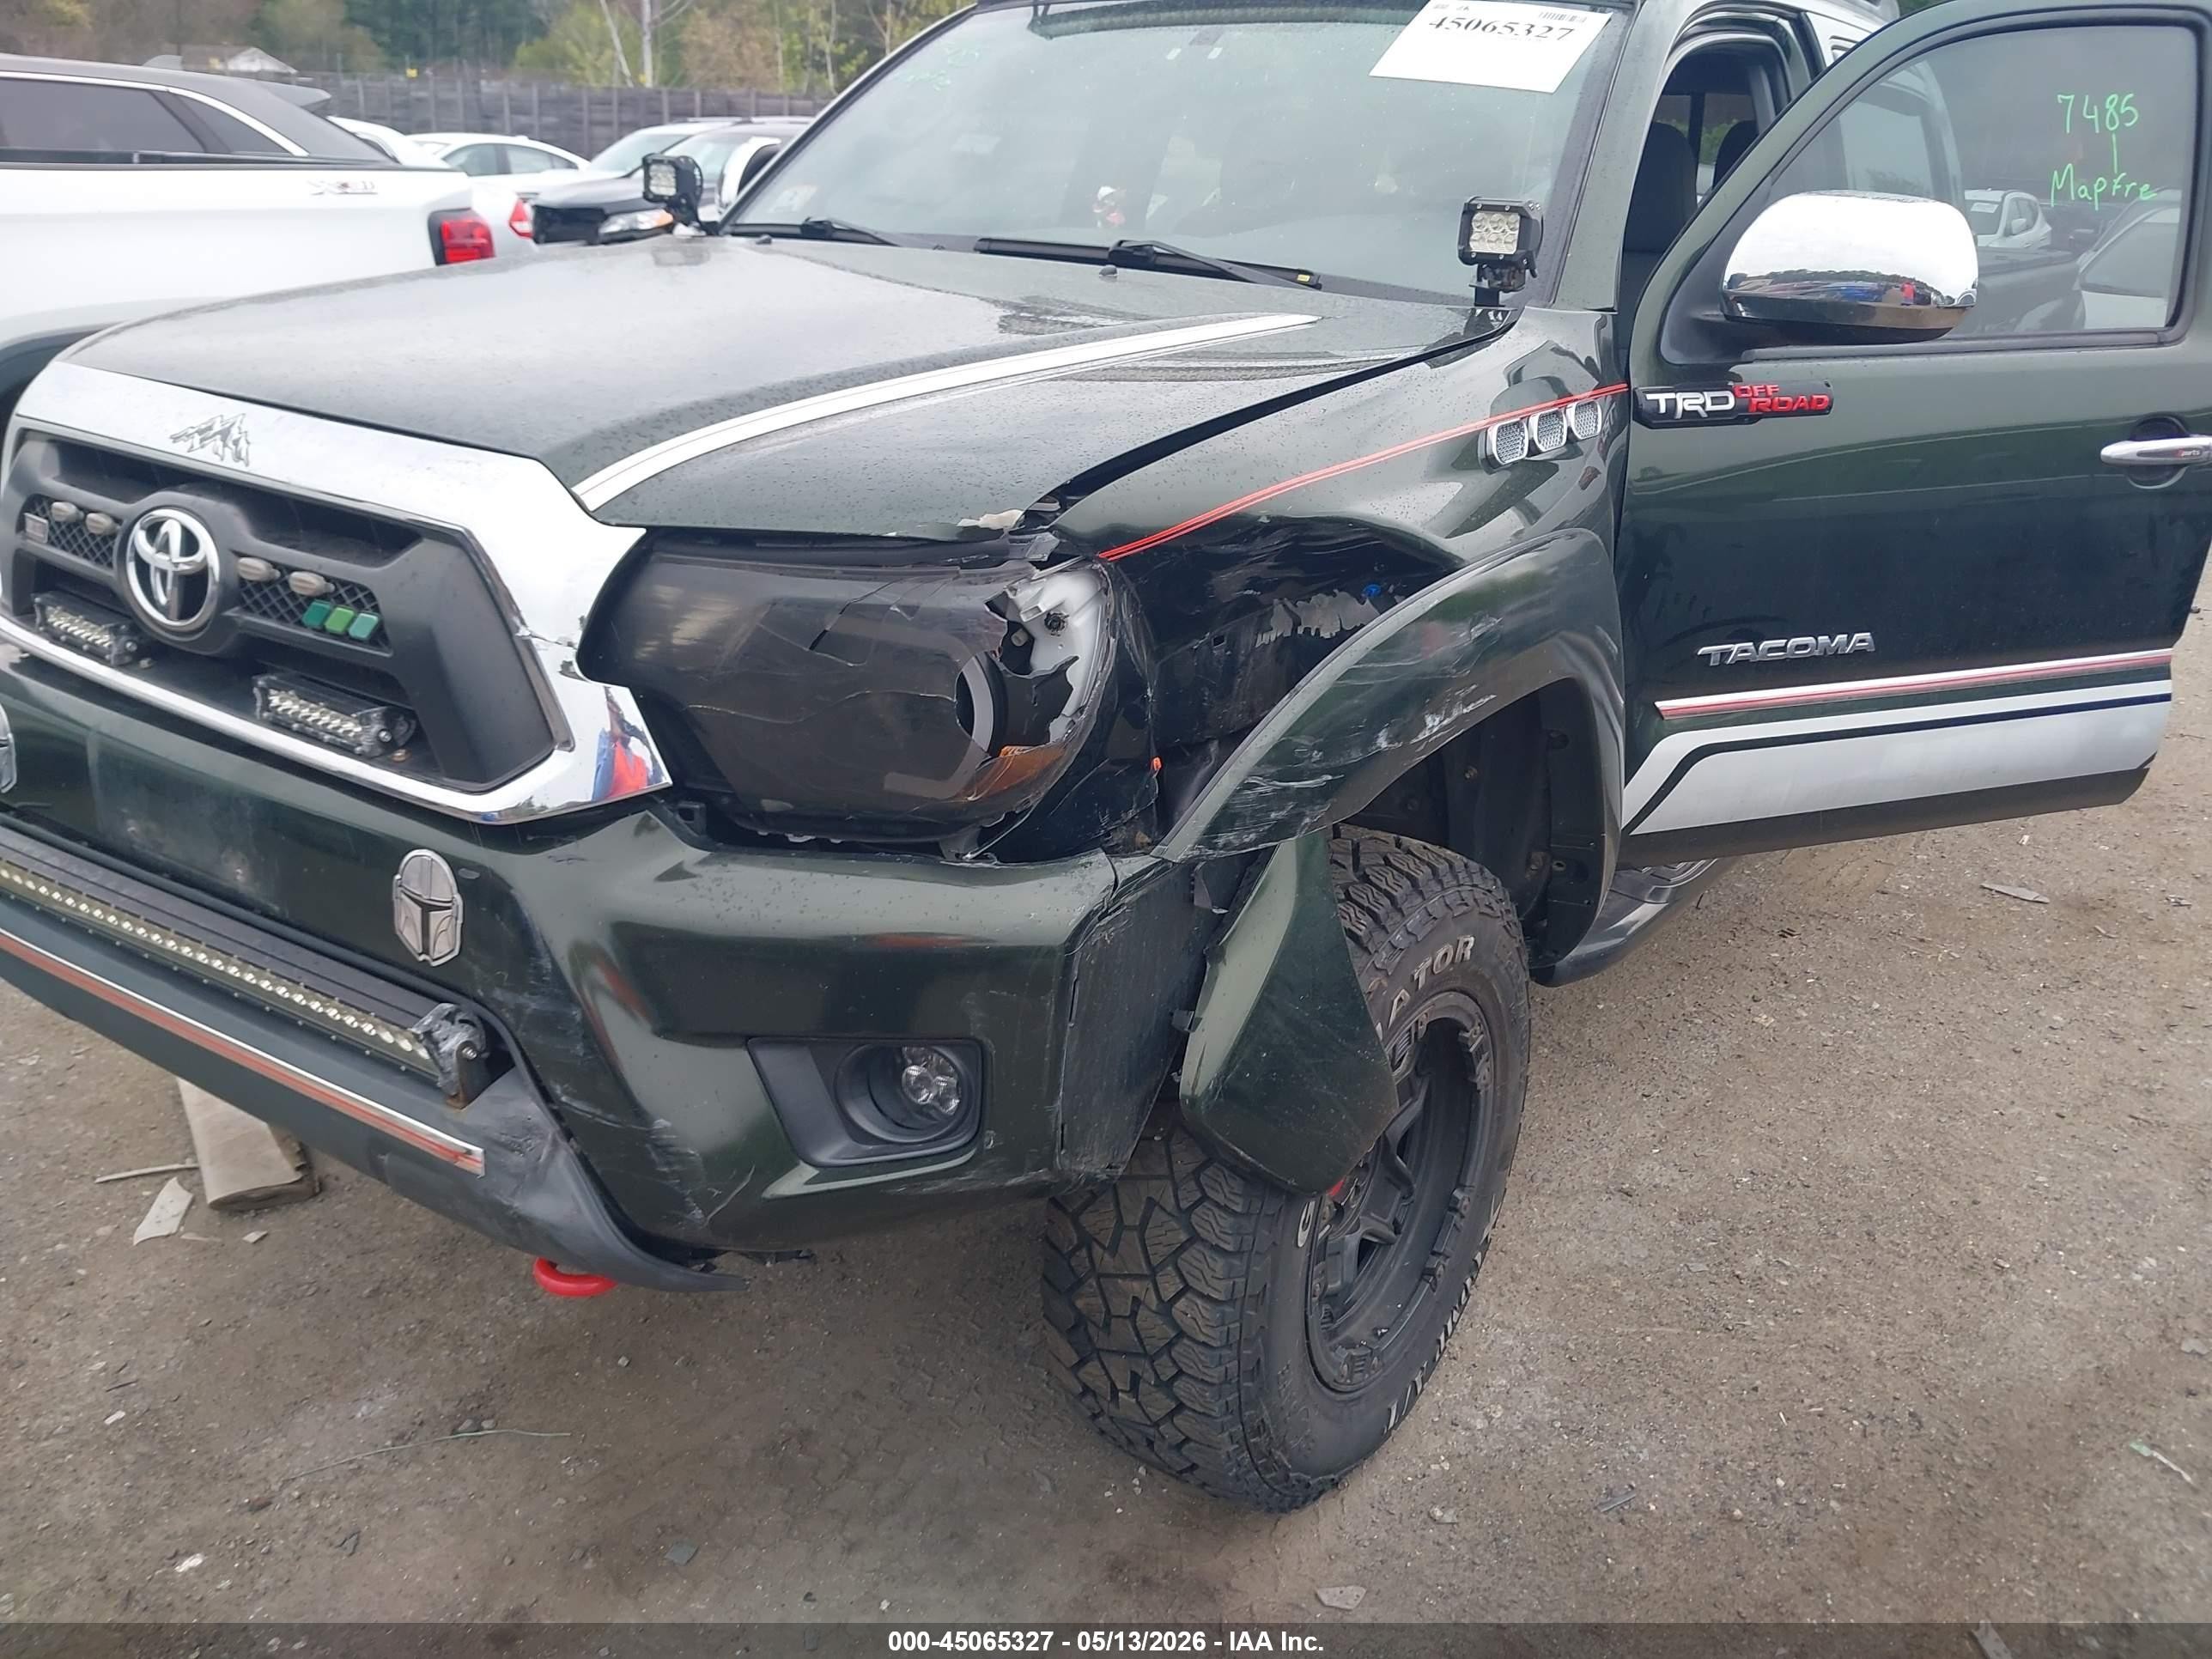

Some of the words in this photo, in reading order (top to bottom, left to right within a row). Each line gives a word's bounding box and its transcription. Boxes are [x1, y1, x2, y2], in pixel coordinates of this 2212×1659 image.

[1428, 16, 1576, 40] 45065327
[2057, 93, 2139, 134] 7485
[1733, 384, 1780, 398] OFF
[1748, 394, 1830, 413] ROAD
[1645, 390, 1736, 420] TRD
[1697, 631, 1876, 666] TACOMA
